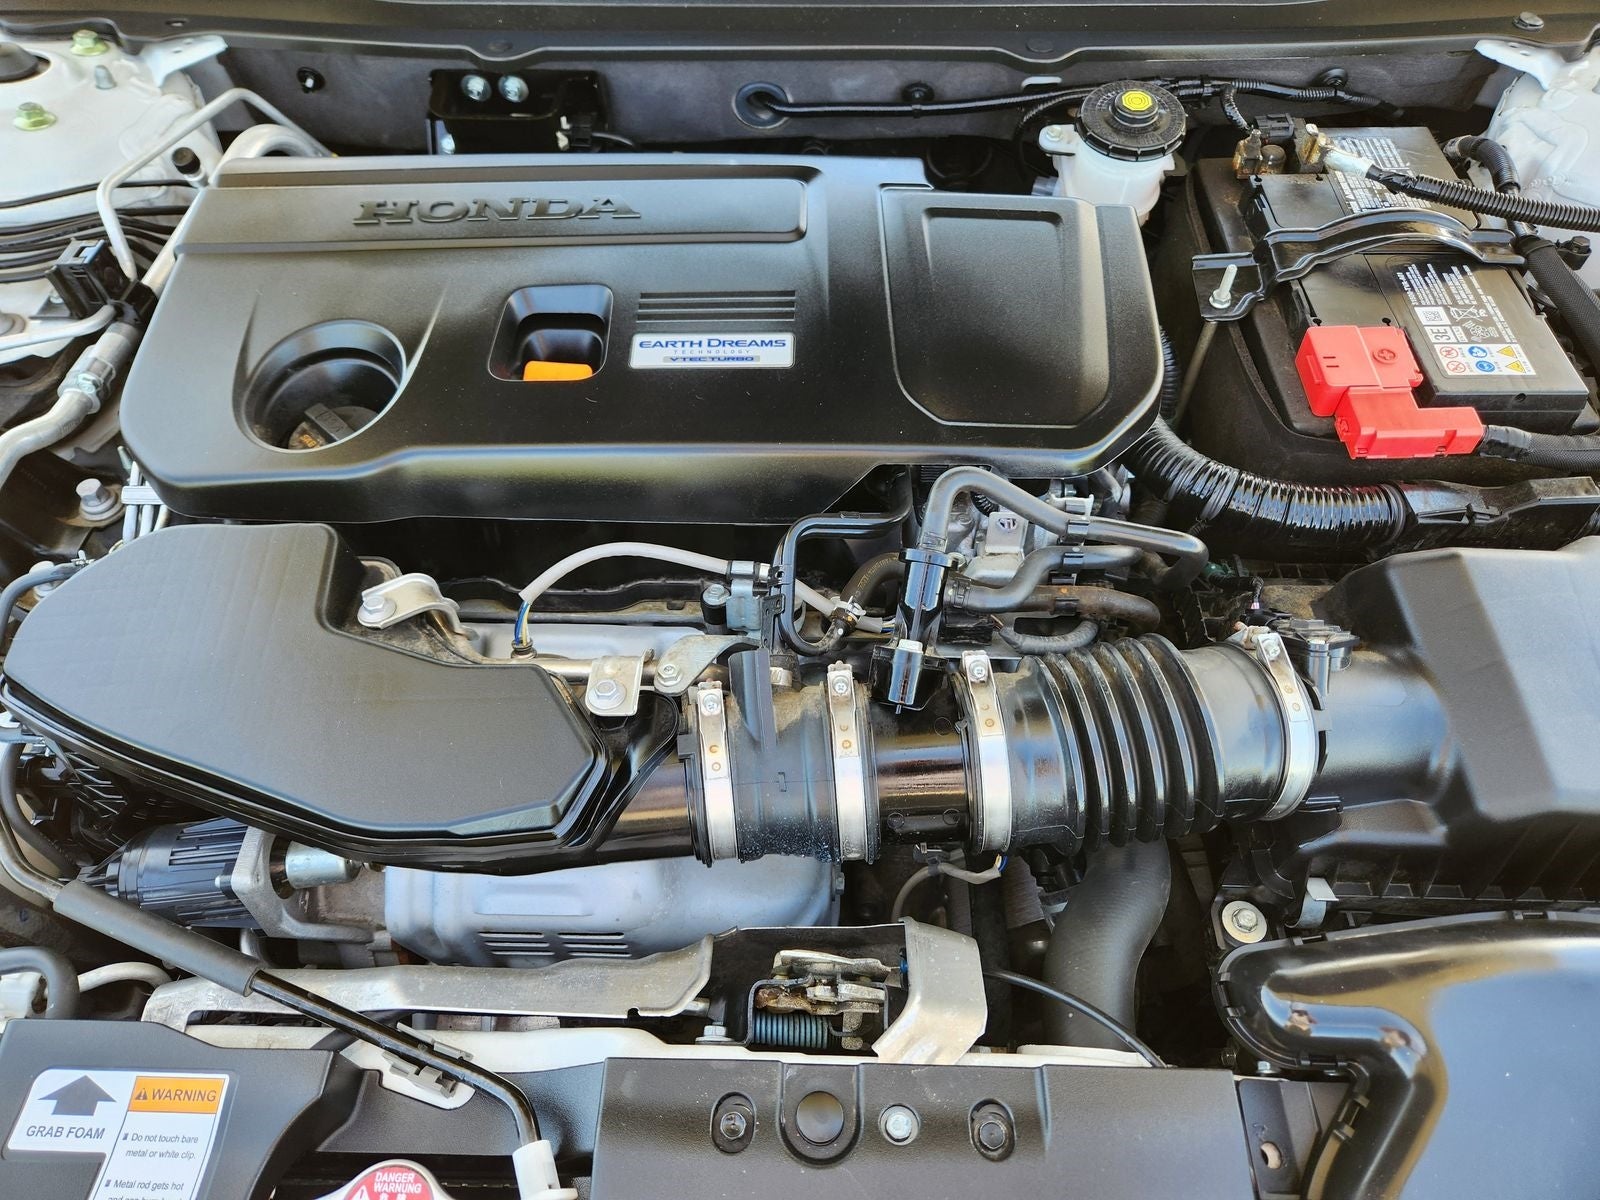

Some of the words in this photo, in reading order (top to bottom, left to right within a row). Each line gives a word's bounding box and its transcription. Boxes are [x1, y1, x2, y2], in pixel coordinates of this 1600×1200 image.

[352, 197, 641, 225] HONDA
[639, 340, 703, 349] EARTH
[707, 338, 786, 348] DREAMS
[152, 1088, 217, 1102] WARNING
[26, 1125, 64, 1138] GRAB
[67, 1126, 106, 1140] FOAM
[131, 1133, 144, 1142] Do
[145, 1133, 158, 1143] not
[159, 1134, 179, 1143] touch
[181, 1135, 199, 1144] bare
[126, 1149, 147, 1158] metal
[159, 1150, 179, 1159] white
[181, 1151, 196, 1161] clip.
[375, 1171, 415, 1183] DANGER
[114, 1179, 136, 1188] Metal
[137, 1180, 151, 1189] rod
[151, 1181, 169, 1191] gets
[171, 1181, 184, 1191] hot
[374, 1182, 422, 1194] WARNUNG
